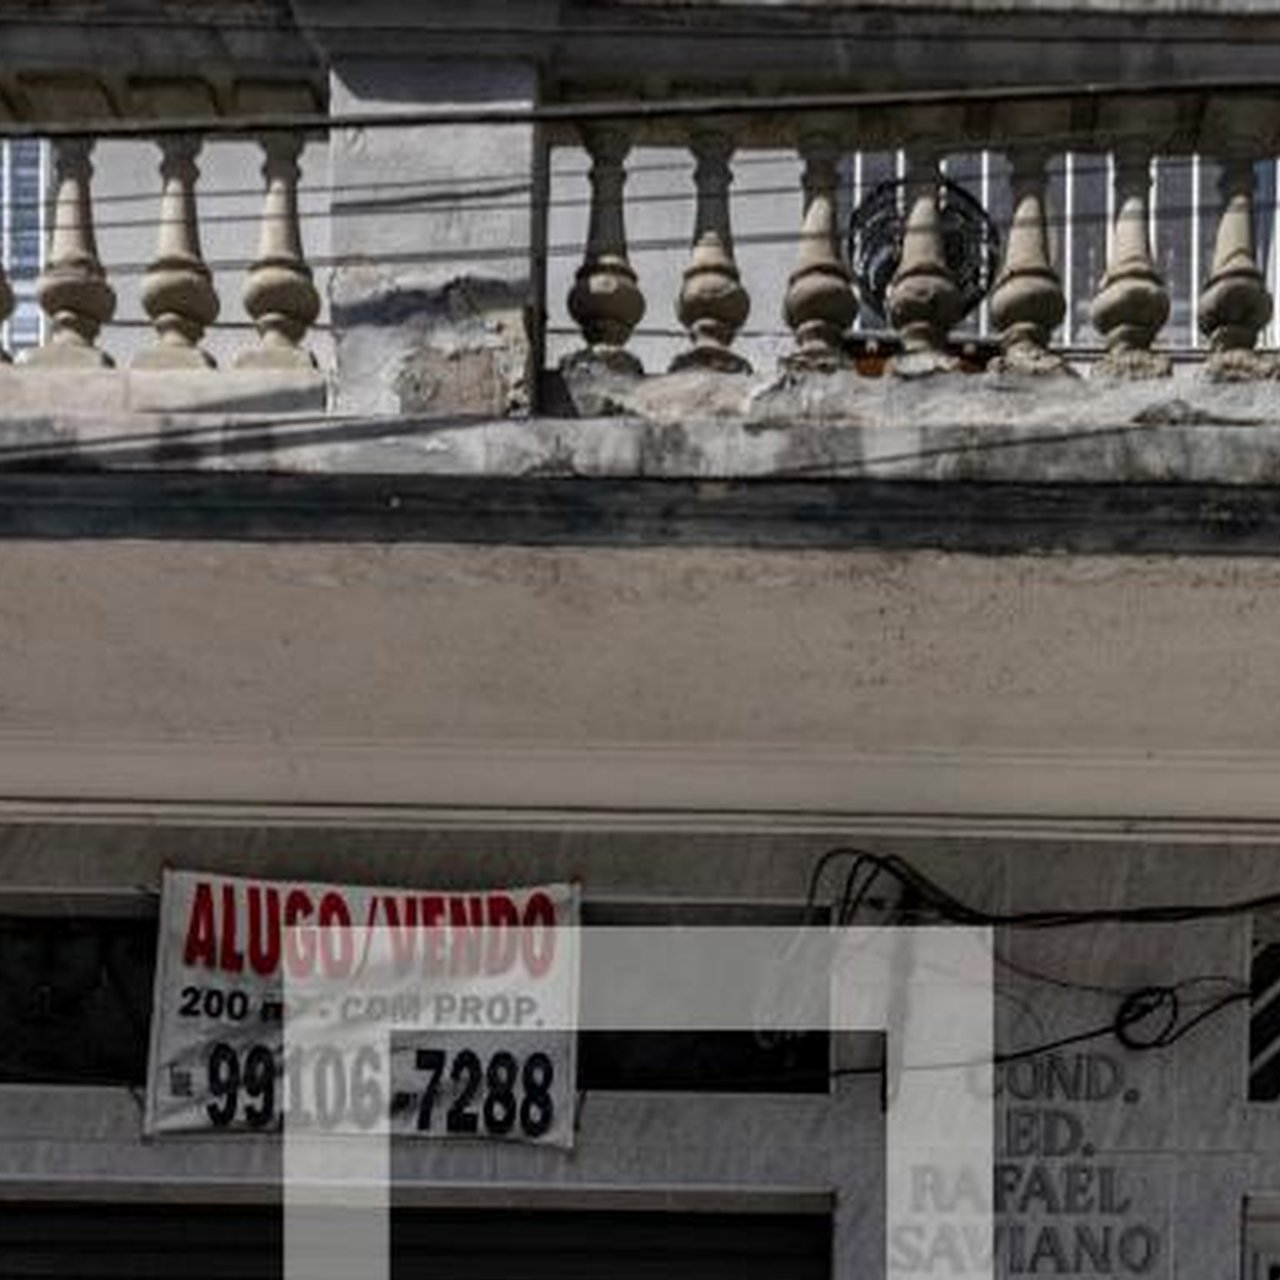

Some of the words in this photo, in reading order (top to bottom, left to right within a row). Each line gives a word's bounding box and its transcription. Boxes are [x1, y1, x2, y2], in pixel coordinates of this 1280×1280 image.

[182, 882, 557, 984] ALUGO/VENDO
[179, 986, 248, 1020] 200
[340, 994, 427, 1024] COM
[434, 995, 545, 1027] PROP.
[1006, 1108, 1094, 1157] ED.
[910, 1163, 1131, 1215] RAFAEL
[891, 1225, 1159, 1275] SAVIANO
